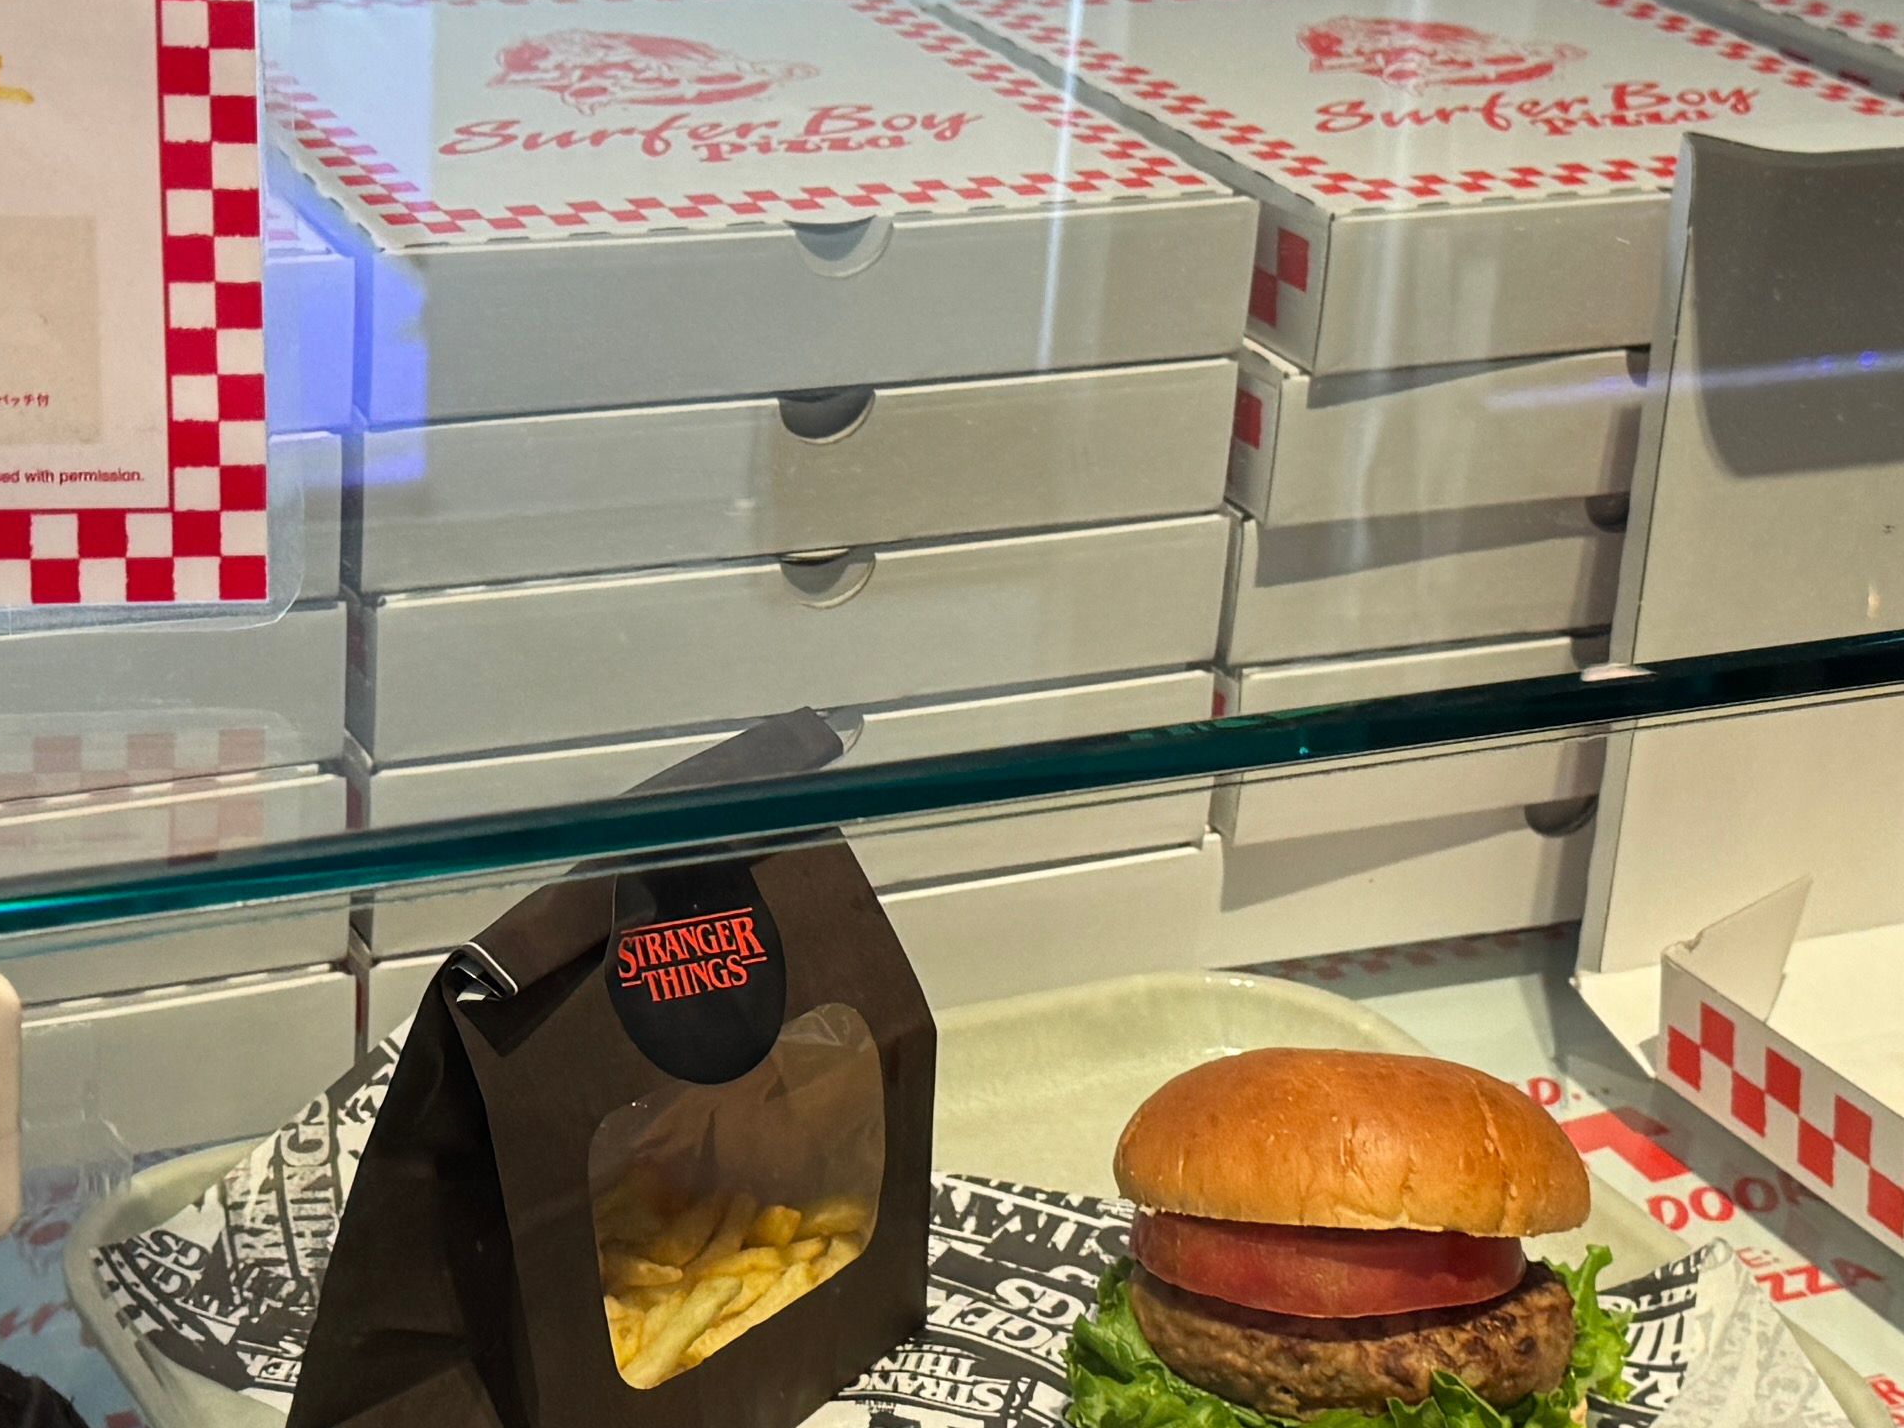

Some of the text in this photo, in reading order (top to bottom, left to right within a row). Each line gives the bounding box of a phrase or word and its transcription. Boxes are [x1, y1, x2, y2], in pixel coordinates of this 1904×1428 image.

[439, 104, 983, 158] Surfer Boy
[1314, 80, 1760, 134] Surfer Boy
[24, 469, 55, 484] with
[617, 916, 766, 979] STRANGER
[642, 954, 748, 1002] THINGS
